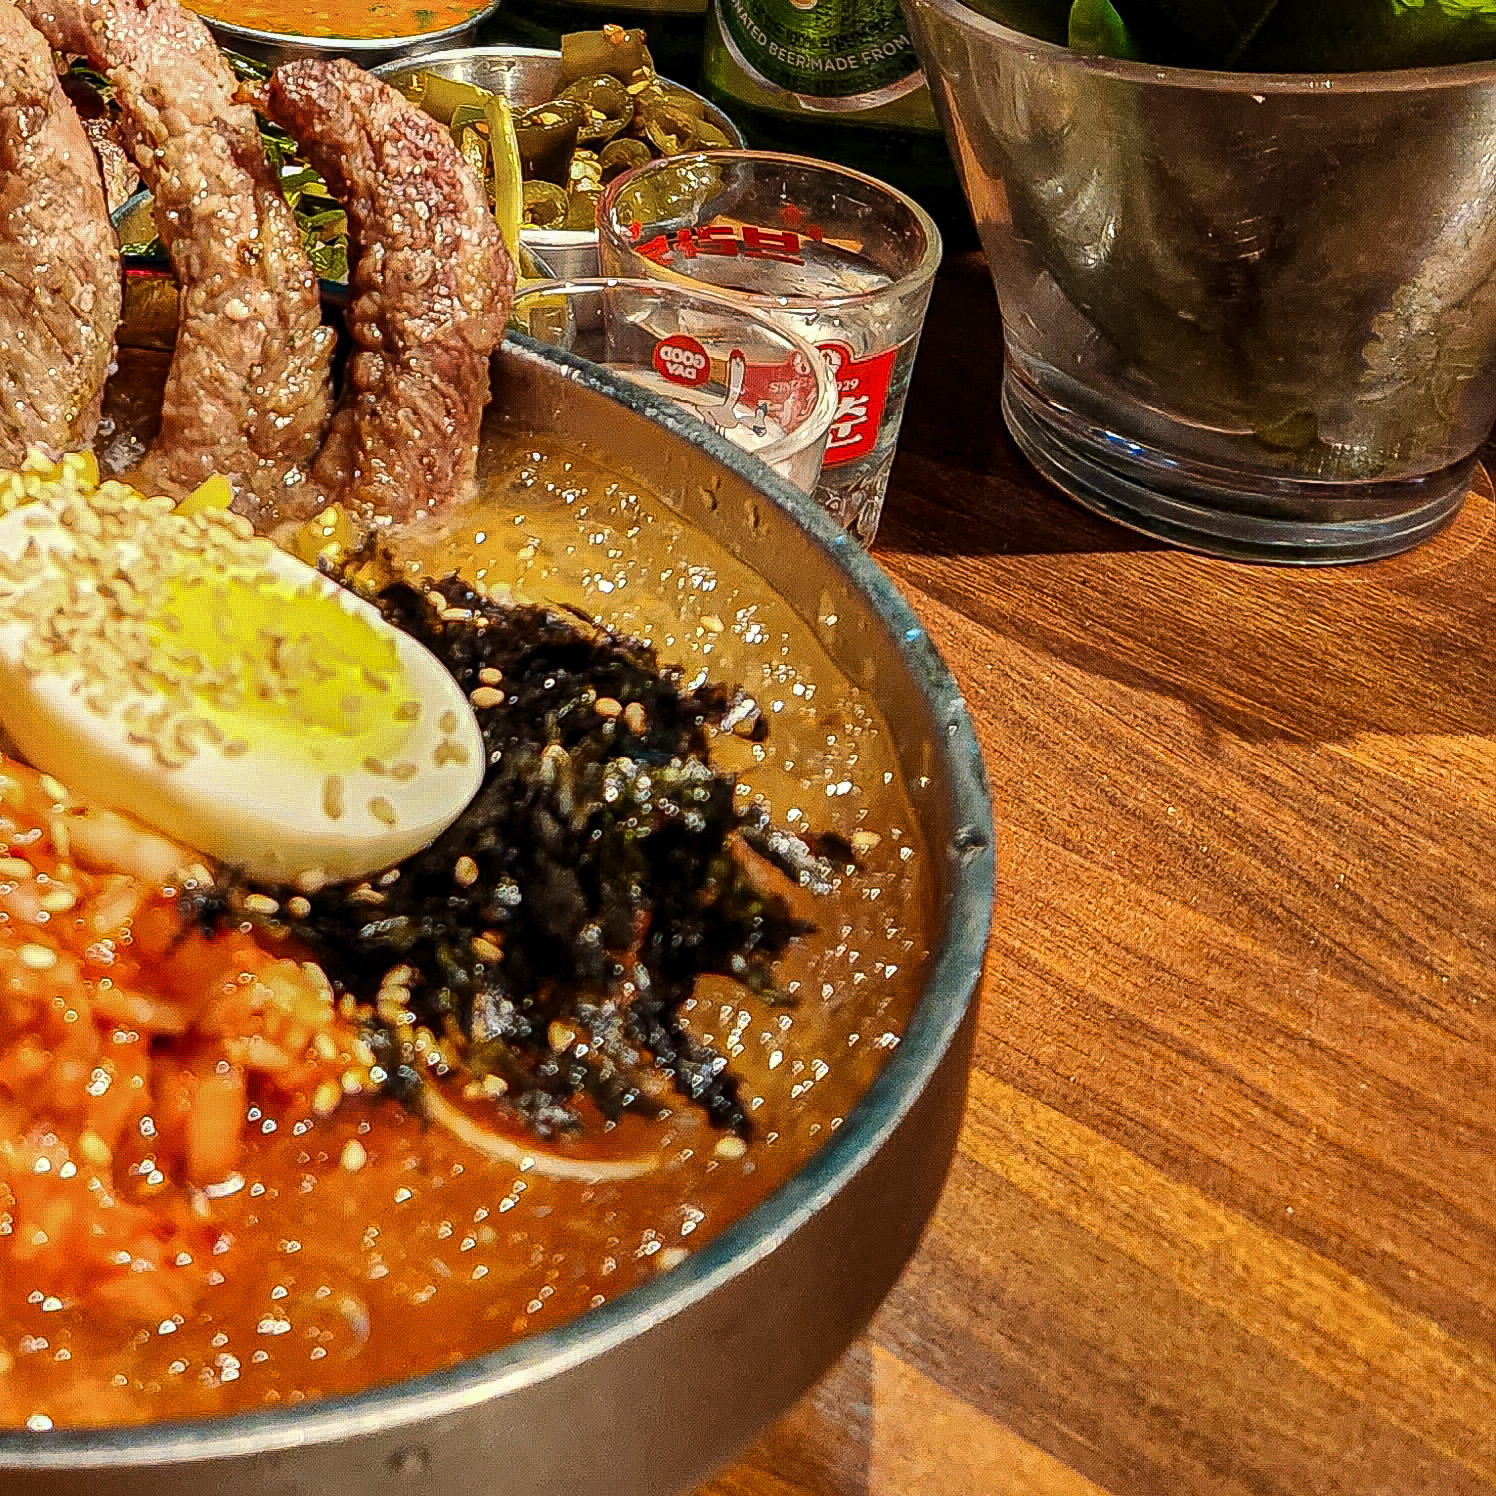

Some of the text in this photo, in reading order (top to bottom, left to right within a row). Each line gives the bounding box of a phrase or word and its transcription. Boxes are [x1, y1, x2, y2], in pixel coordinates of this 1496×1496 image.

[768, 41, 806, 69] BEER
[811, 55, 859, 72] MADE
[861, 33, 911, 66] FROM
